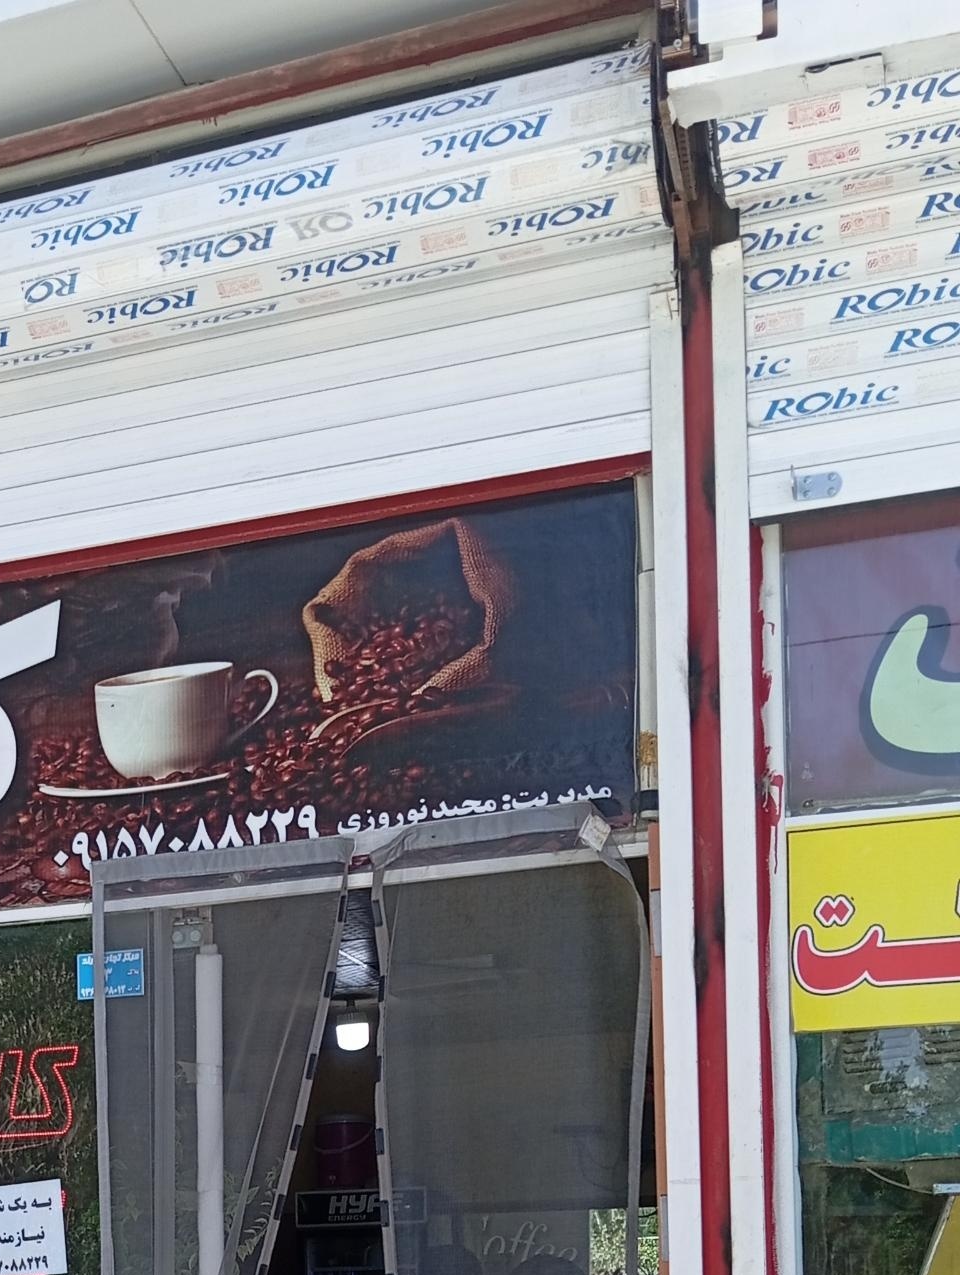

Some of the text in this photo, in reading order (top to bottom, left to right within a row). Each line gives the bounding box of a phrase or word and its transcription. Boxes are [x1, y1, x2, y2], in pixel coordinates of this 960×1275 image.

[744, 259, 850, 294] Obic
[762, 382, 899, 421] RObic
[8, 1197, 27, 1213] یک
[31, 1197, 52, 1210] به
